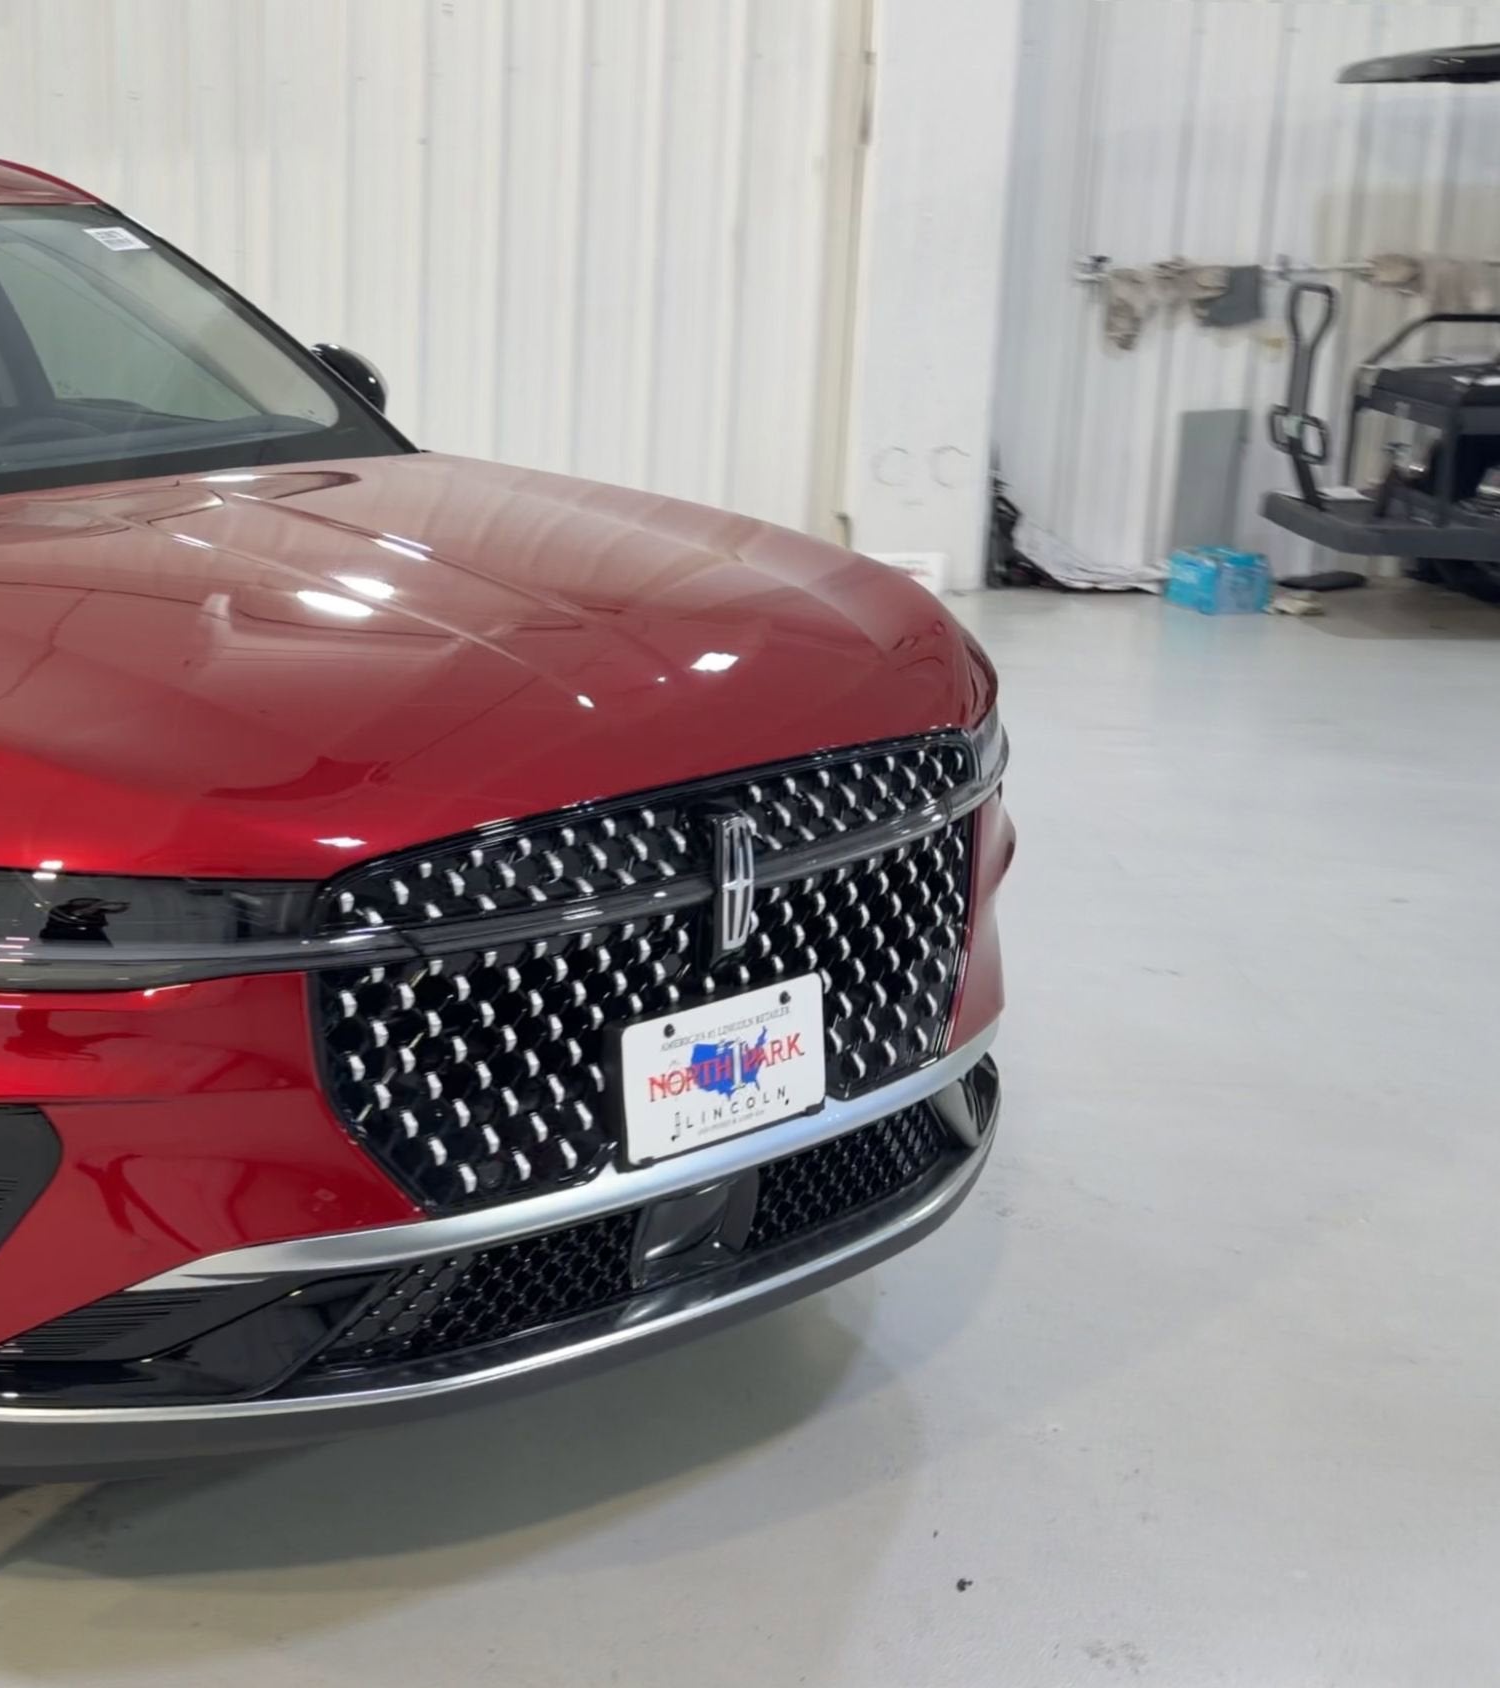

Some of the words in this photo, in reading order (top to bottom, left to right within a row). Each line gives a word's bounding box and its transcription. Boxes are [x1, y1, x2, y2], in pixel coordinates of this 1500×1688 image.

[648, 1054, 734, 1102] NORTH
[742, 1032, 805, 1072] PARK
[687, 1086, 786, 1128] LINCOLN
